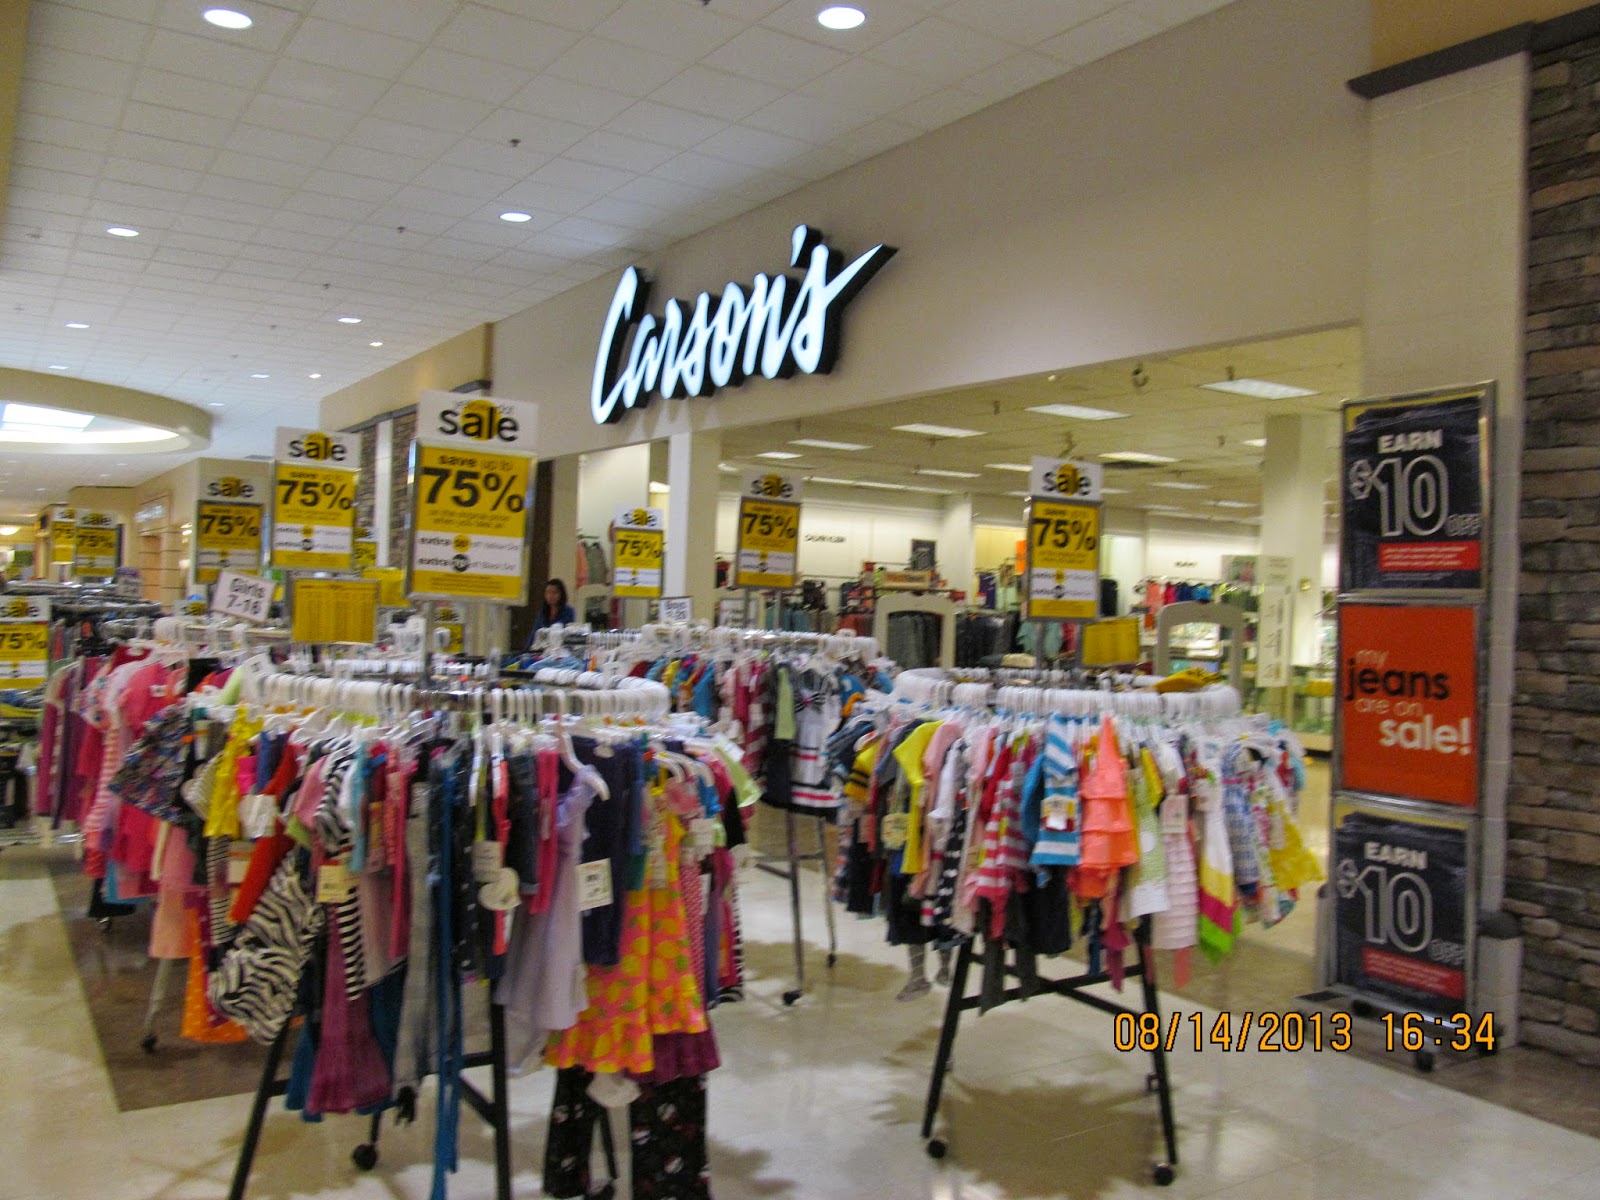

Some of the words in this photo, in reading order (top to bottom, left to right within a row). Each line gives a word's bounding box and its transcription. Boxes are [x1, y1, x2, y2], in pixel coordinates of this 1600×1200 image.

[590, 223, 890, 425] Carson's
[439, 406, 519, 442] sale
[288, 438, 348, 462] sale
[1377, 429, 1443, 453] EARN
[207, 479, 254, 498] sale
[278, 480, 352, 511] 75%
[421, 467, 525, 513] 75%
[750, 476, 794, 499] sale
[1042, 468, 1091, 496] sale
[200, 513, 259, 538] 75%
[622, 511, 658, 528] sale
[742, 513, 797, 539] 75%
[1031, 517, 1097, 551] 75%
[617, 538, 662, 559] 75%
[1345, 657, 1450, 701] jeans
[1355, 698, 1390, 714] are
[1393, 701, 1424, 717] on
[1378, 714, 1472, 756] sale!
[1363, 841, 1428, 870] EARN
